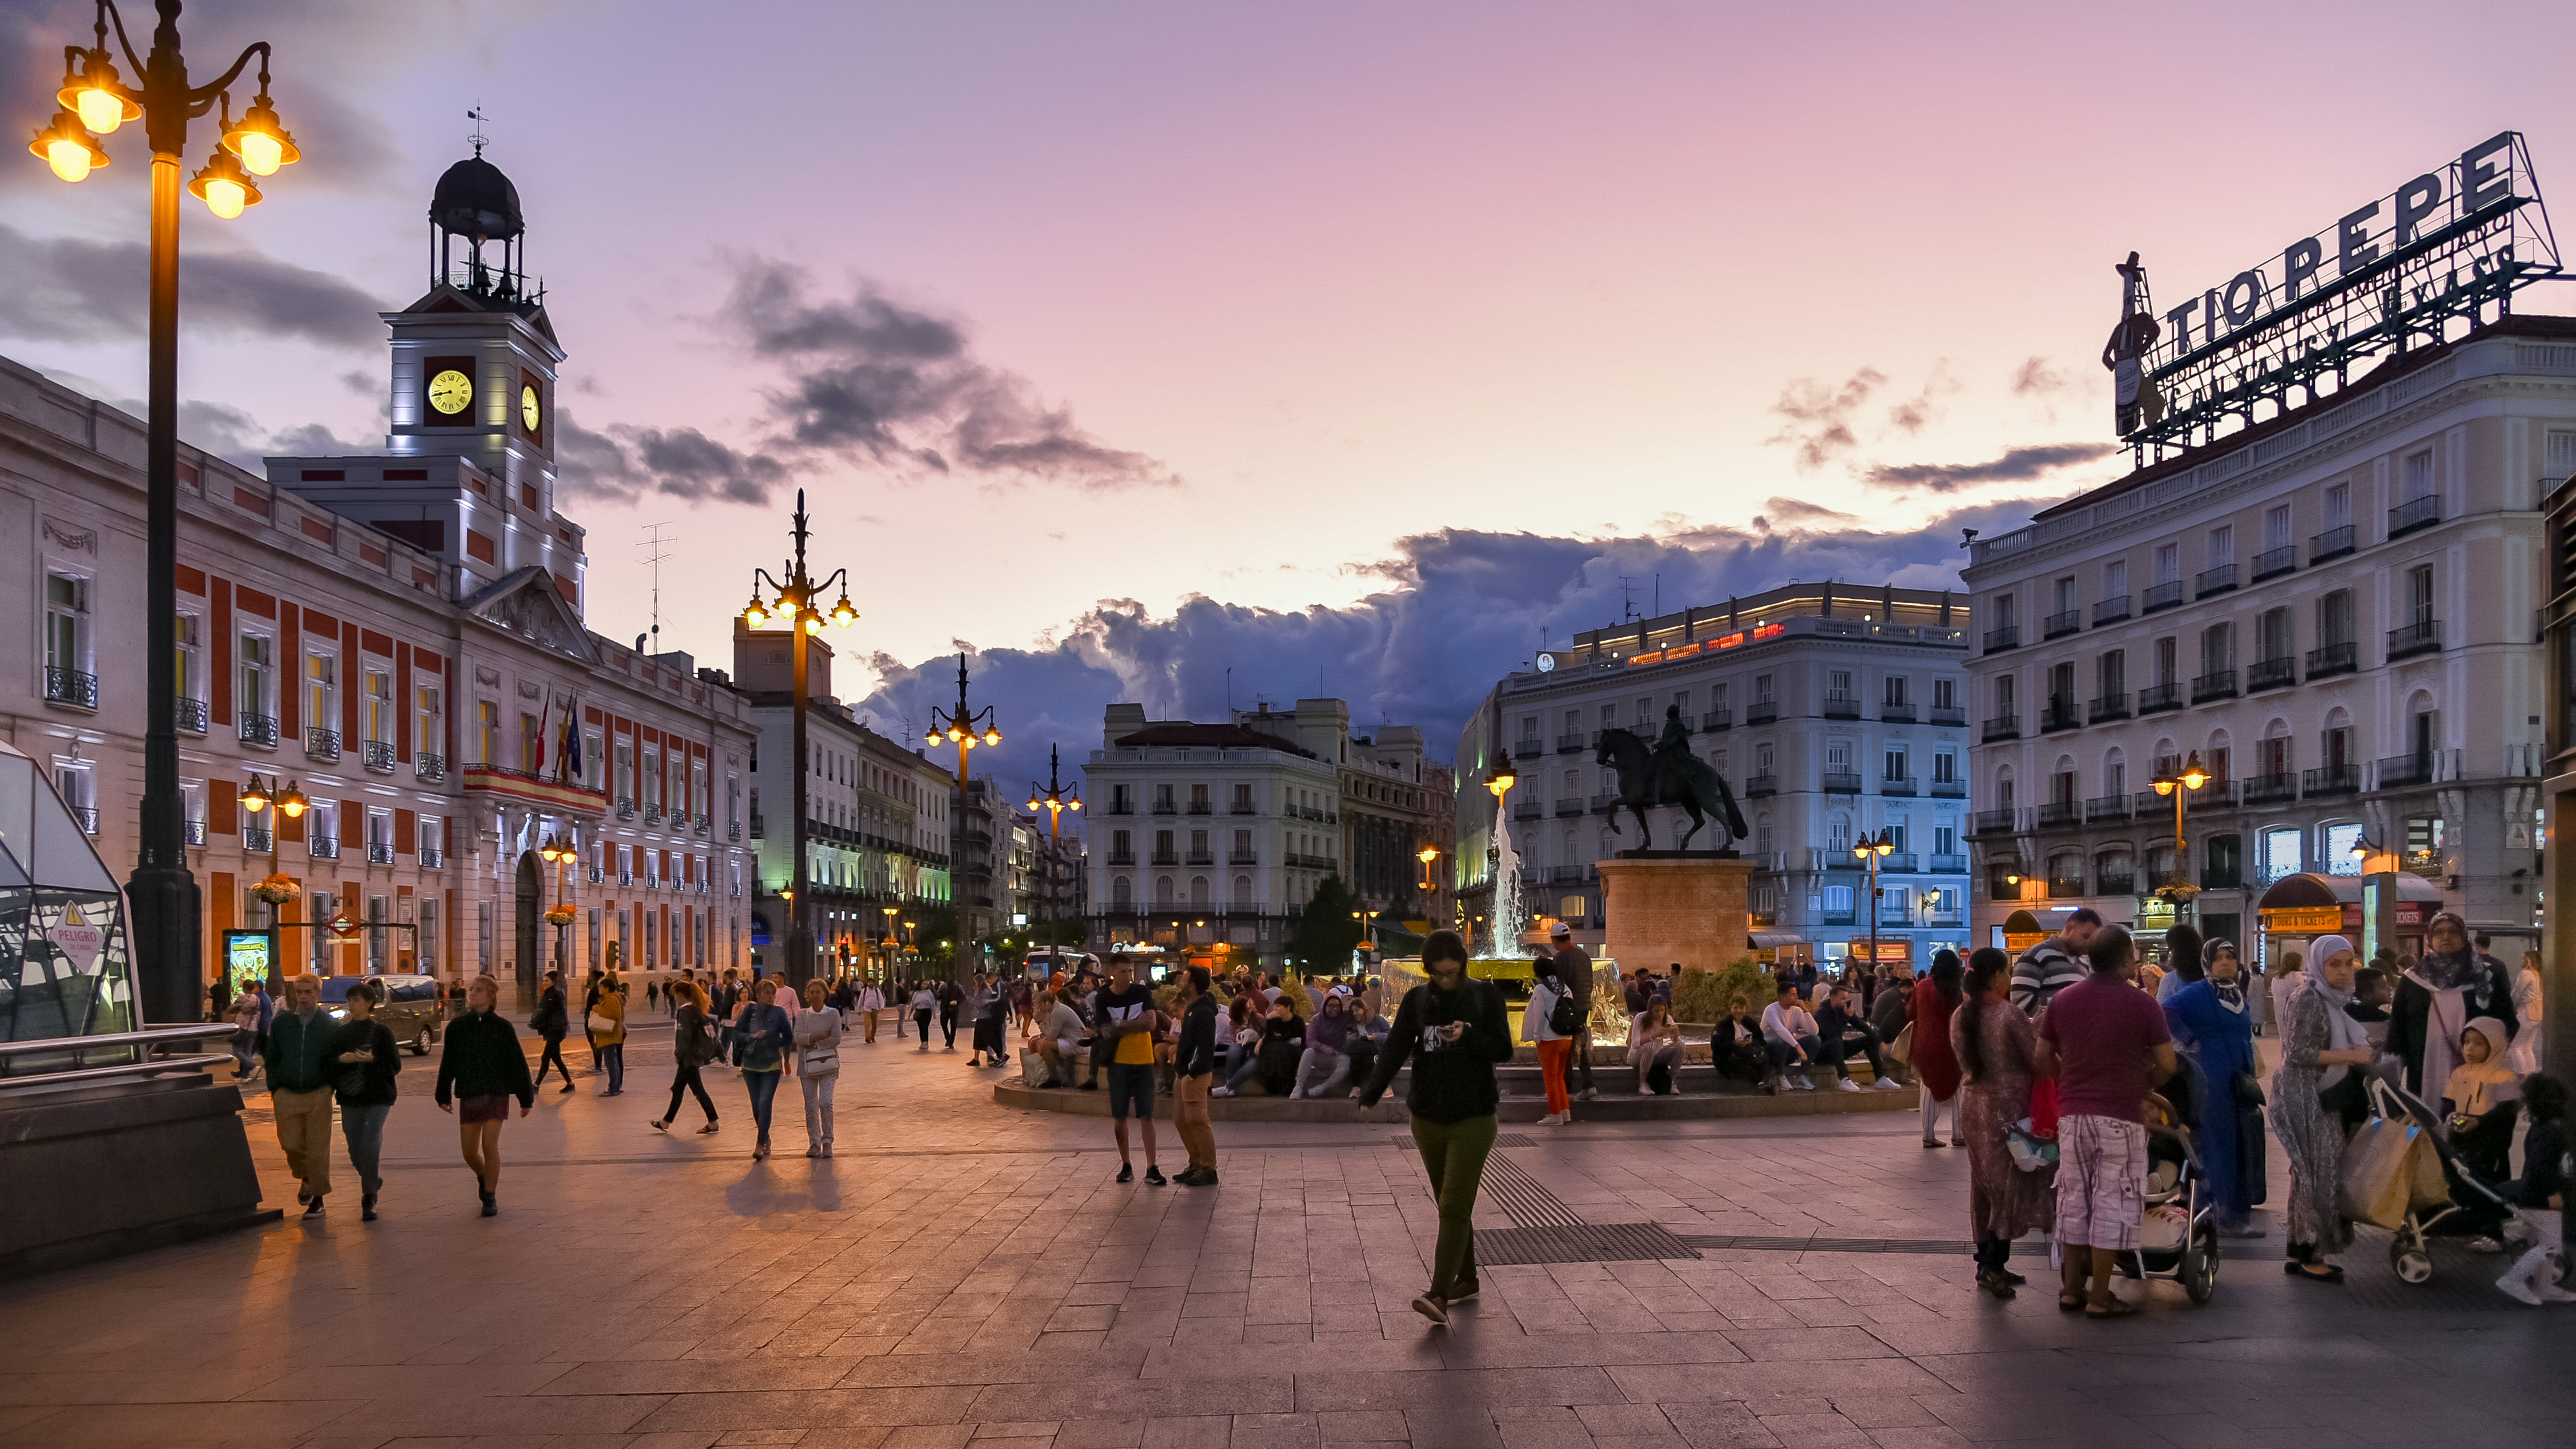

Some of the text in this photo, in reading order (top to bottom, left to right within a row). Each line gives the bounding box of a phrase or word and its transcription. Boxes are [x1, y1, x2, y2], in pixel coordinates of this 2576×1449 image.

[2167, 131, 2510, 355] TIO PEPE
[2273, 916, 2292, 926] TOURS
[2300, 915, 2326, 926] TICKETS
[58, 929, 97, 942] PELIGRO
